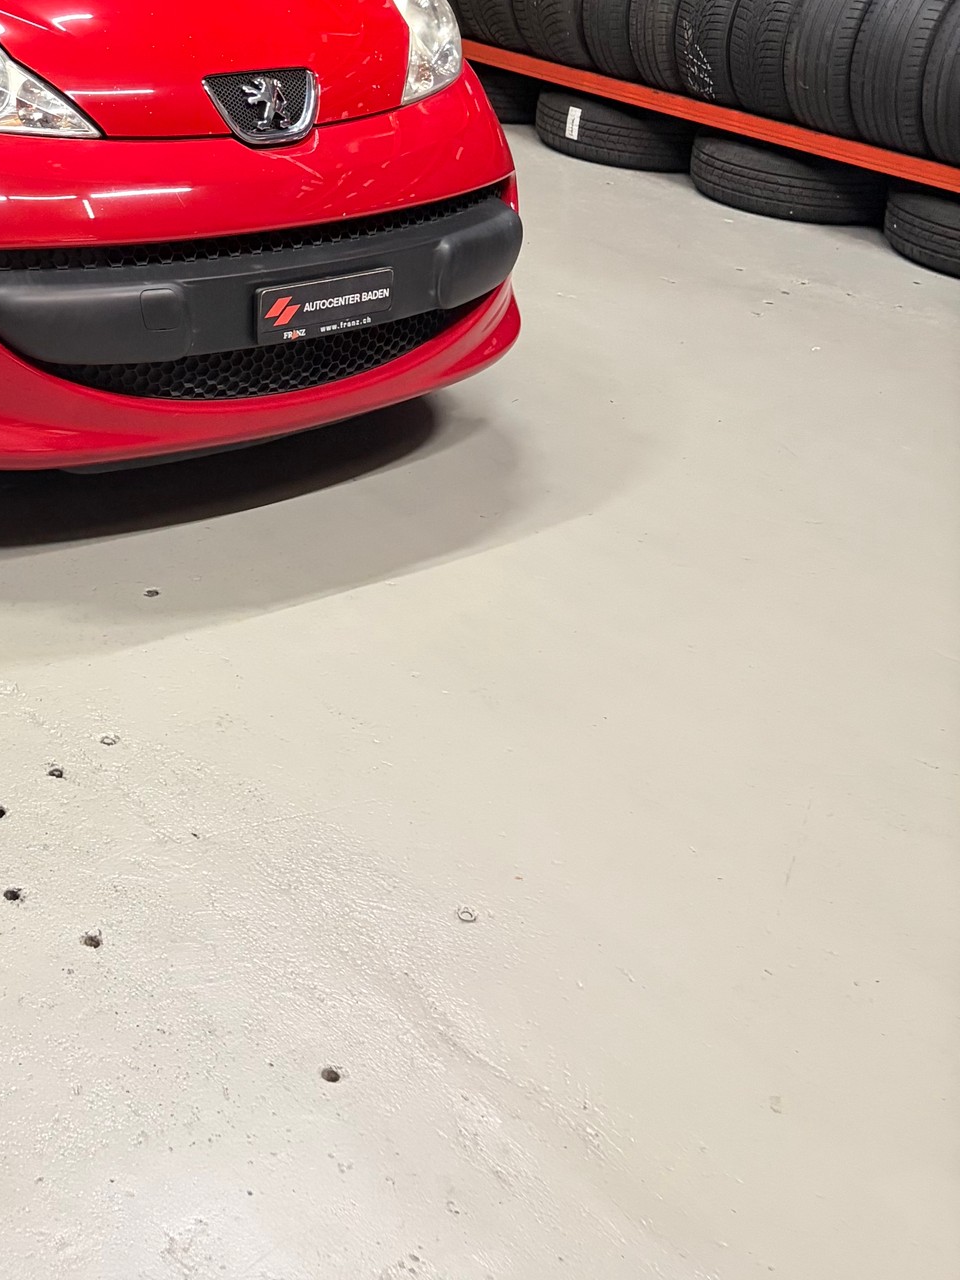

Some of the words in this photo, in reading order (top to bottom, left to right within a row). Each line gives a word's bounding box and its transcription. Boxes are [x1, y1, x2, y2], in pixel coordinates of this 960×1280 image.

[303, 294, 361, 313] AUTOCENTER
[361, 287, 390, 303] BADEN
[319, 315, 372, 333] www.franz.ch
